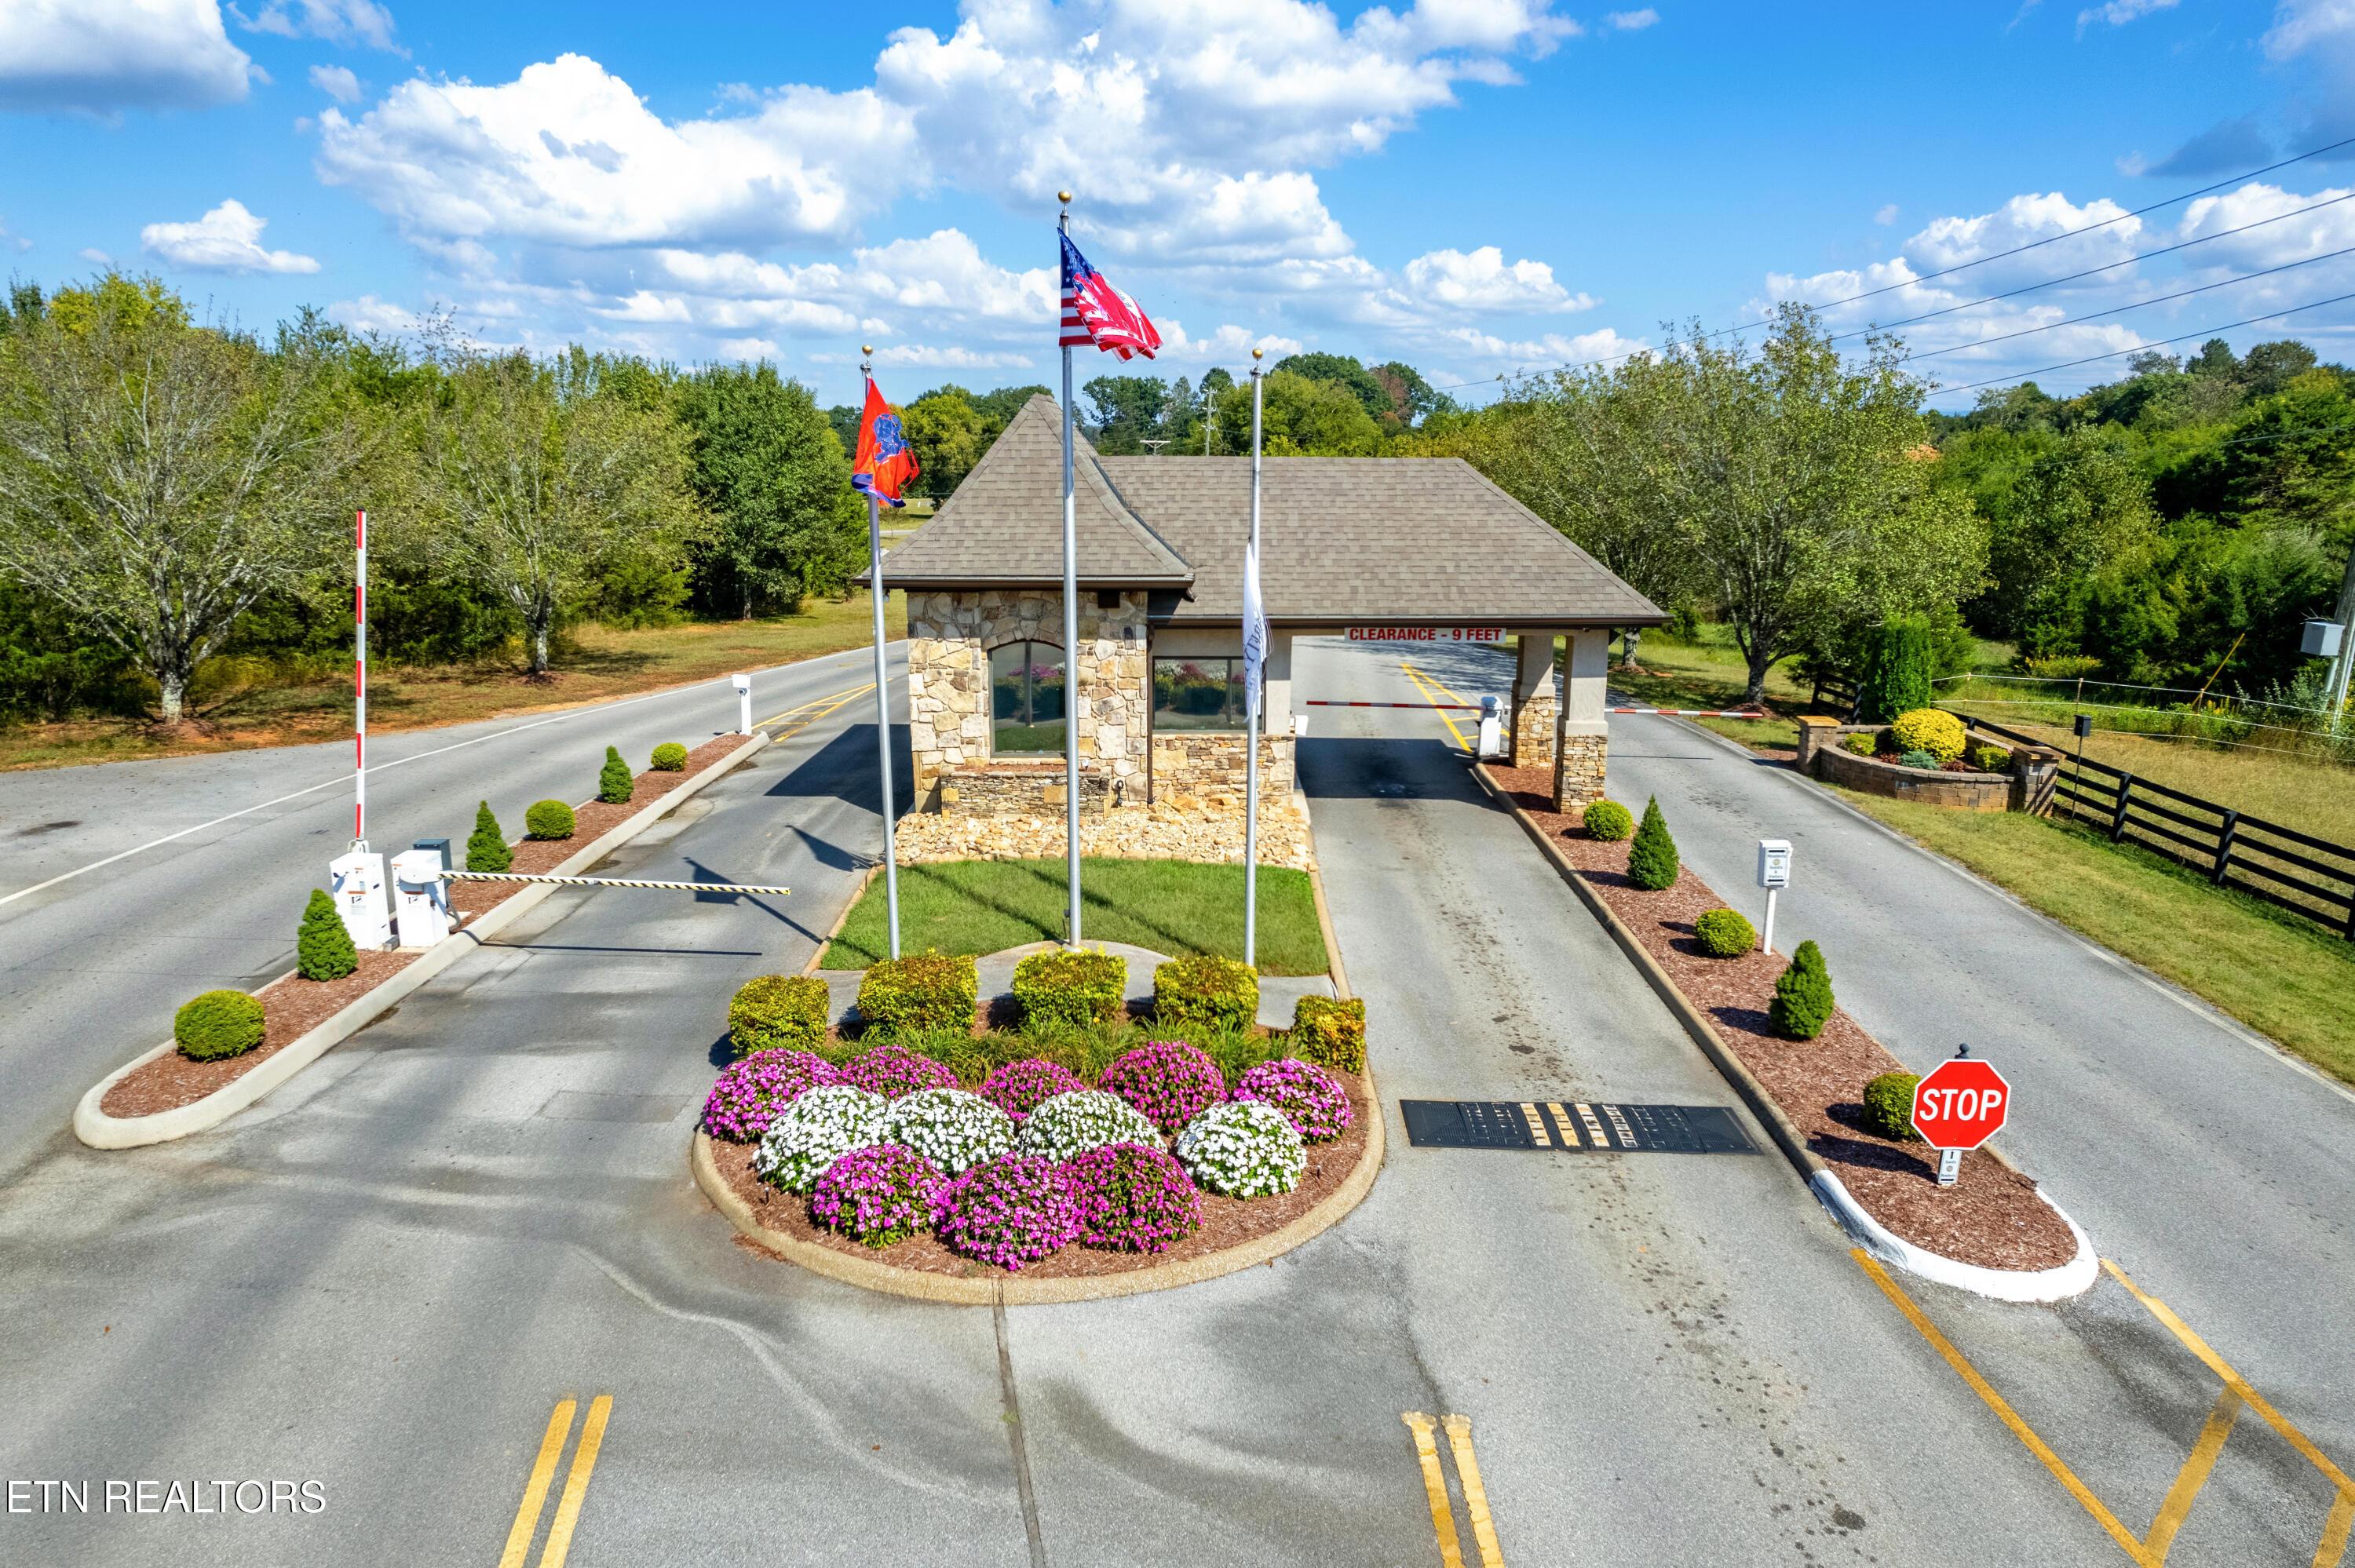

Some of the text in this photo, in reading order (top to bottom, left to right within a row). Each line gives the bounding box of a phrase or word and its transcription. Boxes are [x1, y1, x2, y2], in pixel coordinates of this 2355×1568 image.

[1349, 628, 1437, 641] CLEARANCE
[1452, 629, 1461, 641] 9
[1466, 629, 1502, 641] FEET
[1919, 1088, 2002, 1121] STOP
